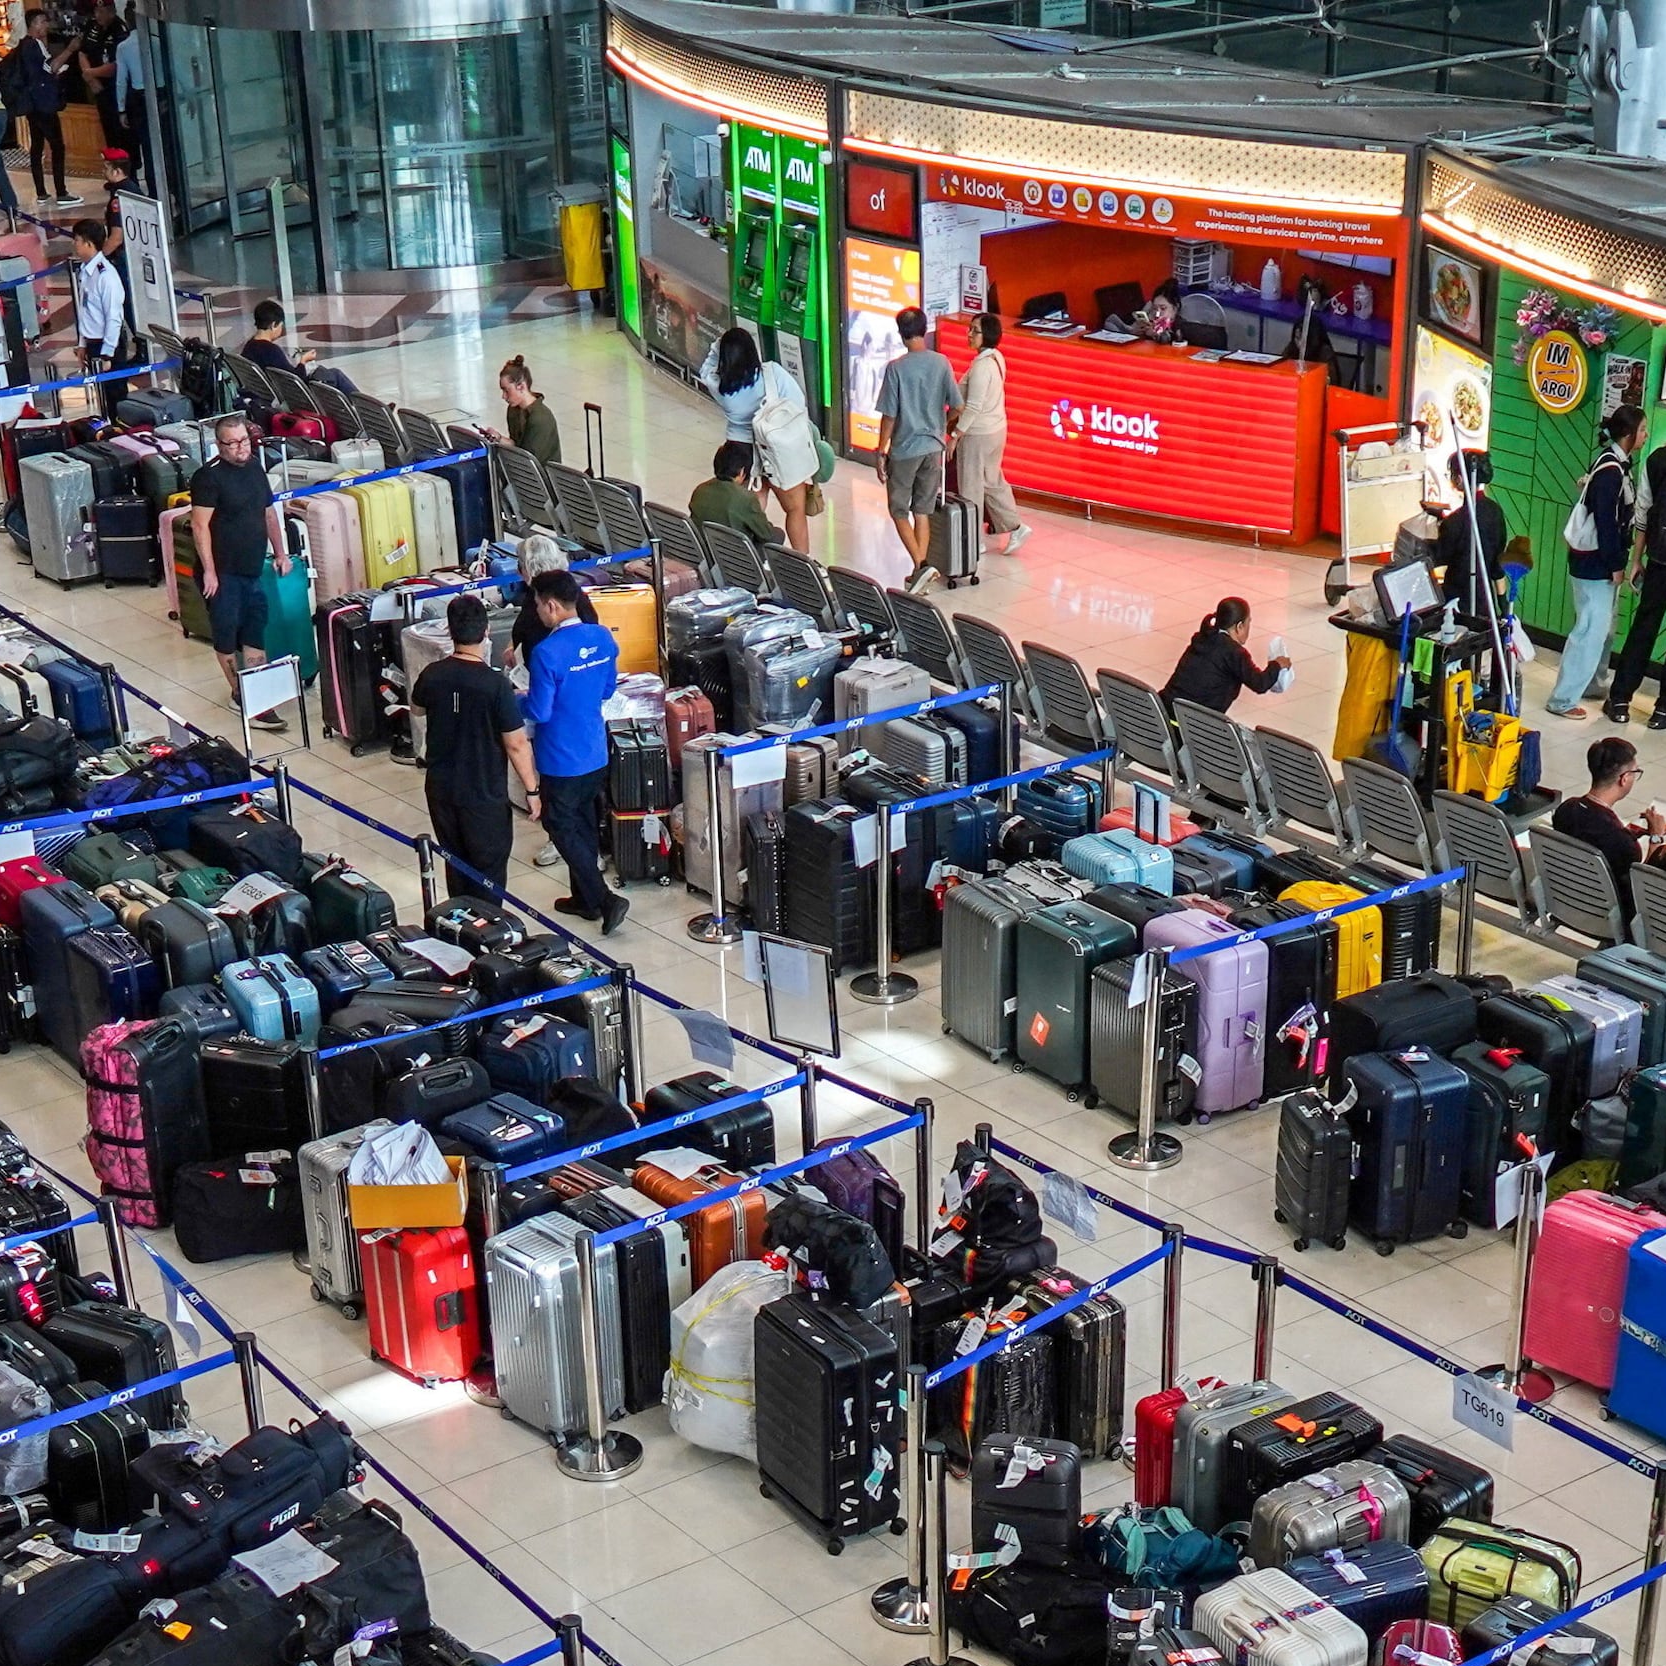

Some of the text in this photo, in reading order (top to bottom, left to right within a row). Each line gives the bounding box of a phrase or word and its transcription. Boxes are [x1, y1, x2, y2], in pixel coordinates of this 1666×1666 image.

[744, 148, 771, 173] ATM
[785, 158, 813, 185] ATM
[964, 177, 1005, 200] klook
[870, 189, 885, 211] of
[1208, 208, 1223, 218] The
[1224, 210, 1256, 224] leading
[1257, 214, 1293, 225] platform
[1308, 219, 1342, 231] booking
[1344, 222, 1370, 231] travel
[125, 215, 161, 249] OUT
[1195, 220, 1383, 245] experiences and services anytime, anywhere
[1545, 341, 1570, 366] IM
[83, 374, 96, 385] AOT
[1540, 379, 1573, 399] AROI
[1091, 405, 1159, 440] klook
[1091, 435, 1111, 445] Your
[1112, 438, 1134, 451] world
[1135, 443, 1144, 451] of
[400, 465, 414, 474] AOT
[339, 479, 353, 487] AOT
[596, 555, 611, 565] AOT
[462, 581, 479, 591] AOT
[846, 717, 864, 728] AOT
[92, 808, 111, 818] AOT
[239, 882, 266, 900] TG935
[1391, 885, 1409, 898] AOT
[523, 996, 543, 1004] AOT
[674, 1112, 694, 1127] AOT
[581, 1142, 601, 1157] AOT
[830, 1142, 850, 1157] AOT
[1095, 1193, 1114, 1206] AOT
[1089, 1277, 1108, 1295] AOT
[109, 1388, 135, 1408] AOT
[1462, 1389, 1504, 1427] TG619
[1628, 1458, 1653, 1474] AOT
[1590, 1591, 1613, 1609] AOT
